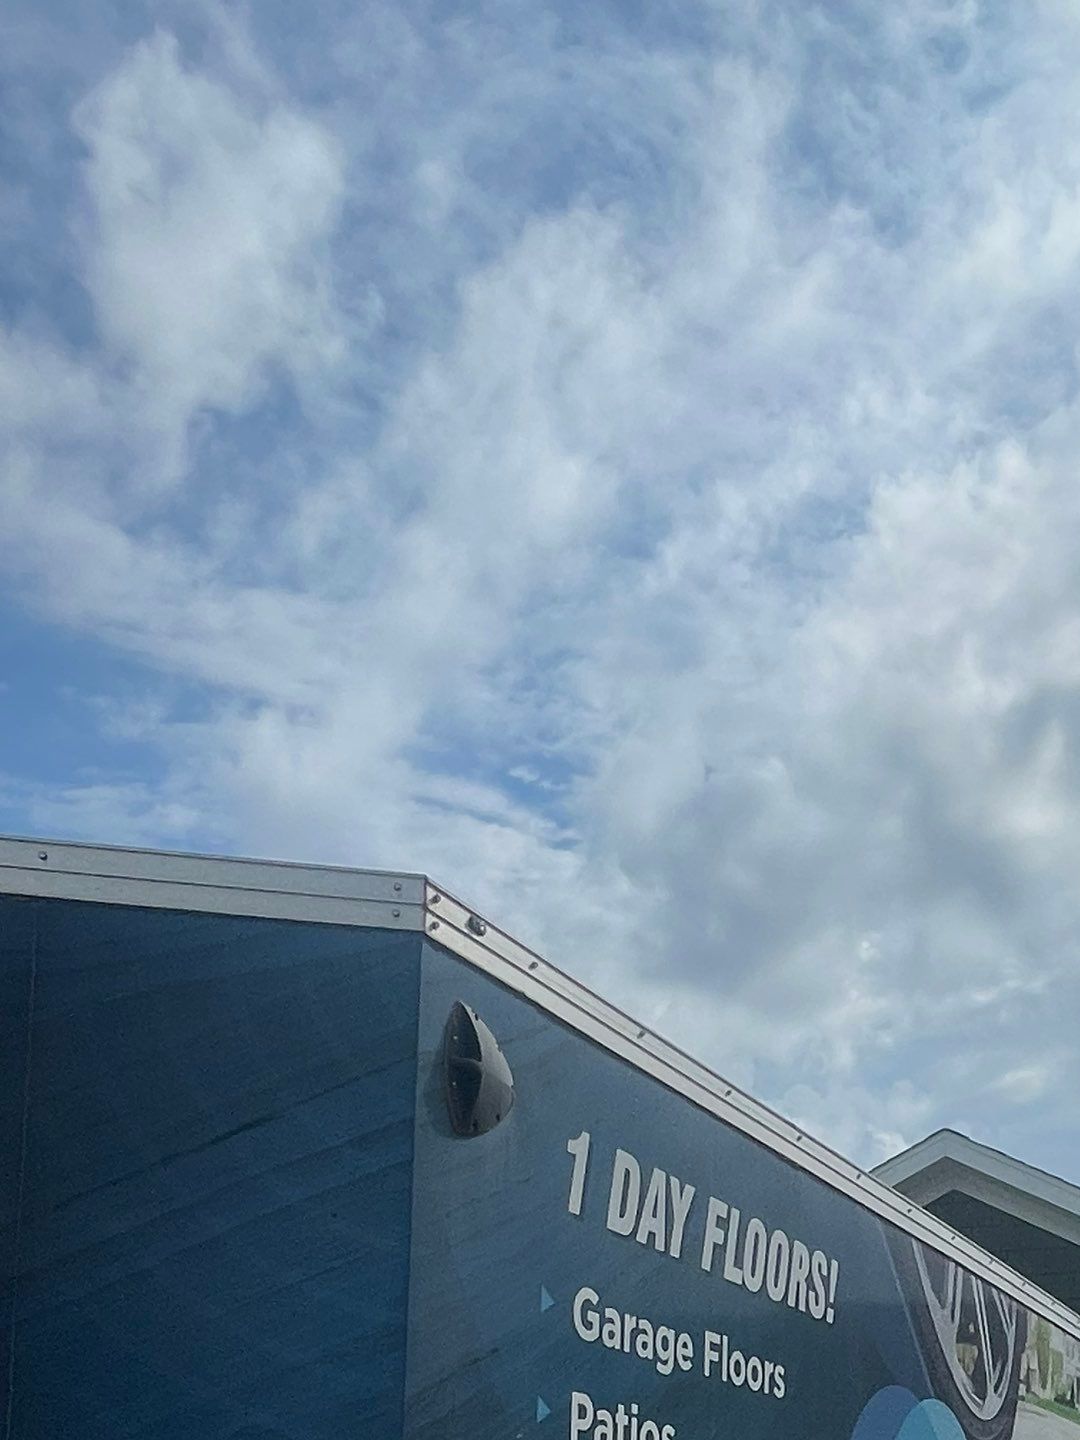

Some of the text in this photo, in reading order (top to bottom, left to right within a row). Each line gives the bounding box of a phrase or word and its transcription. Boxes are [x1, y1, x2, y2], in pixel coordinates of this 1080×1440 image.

[567, 1131, 839, 1325] 1 DAY FLOORS!
[572, 1286, 788, 1400] Garage Floors
